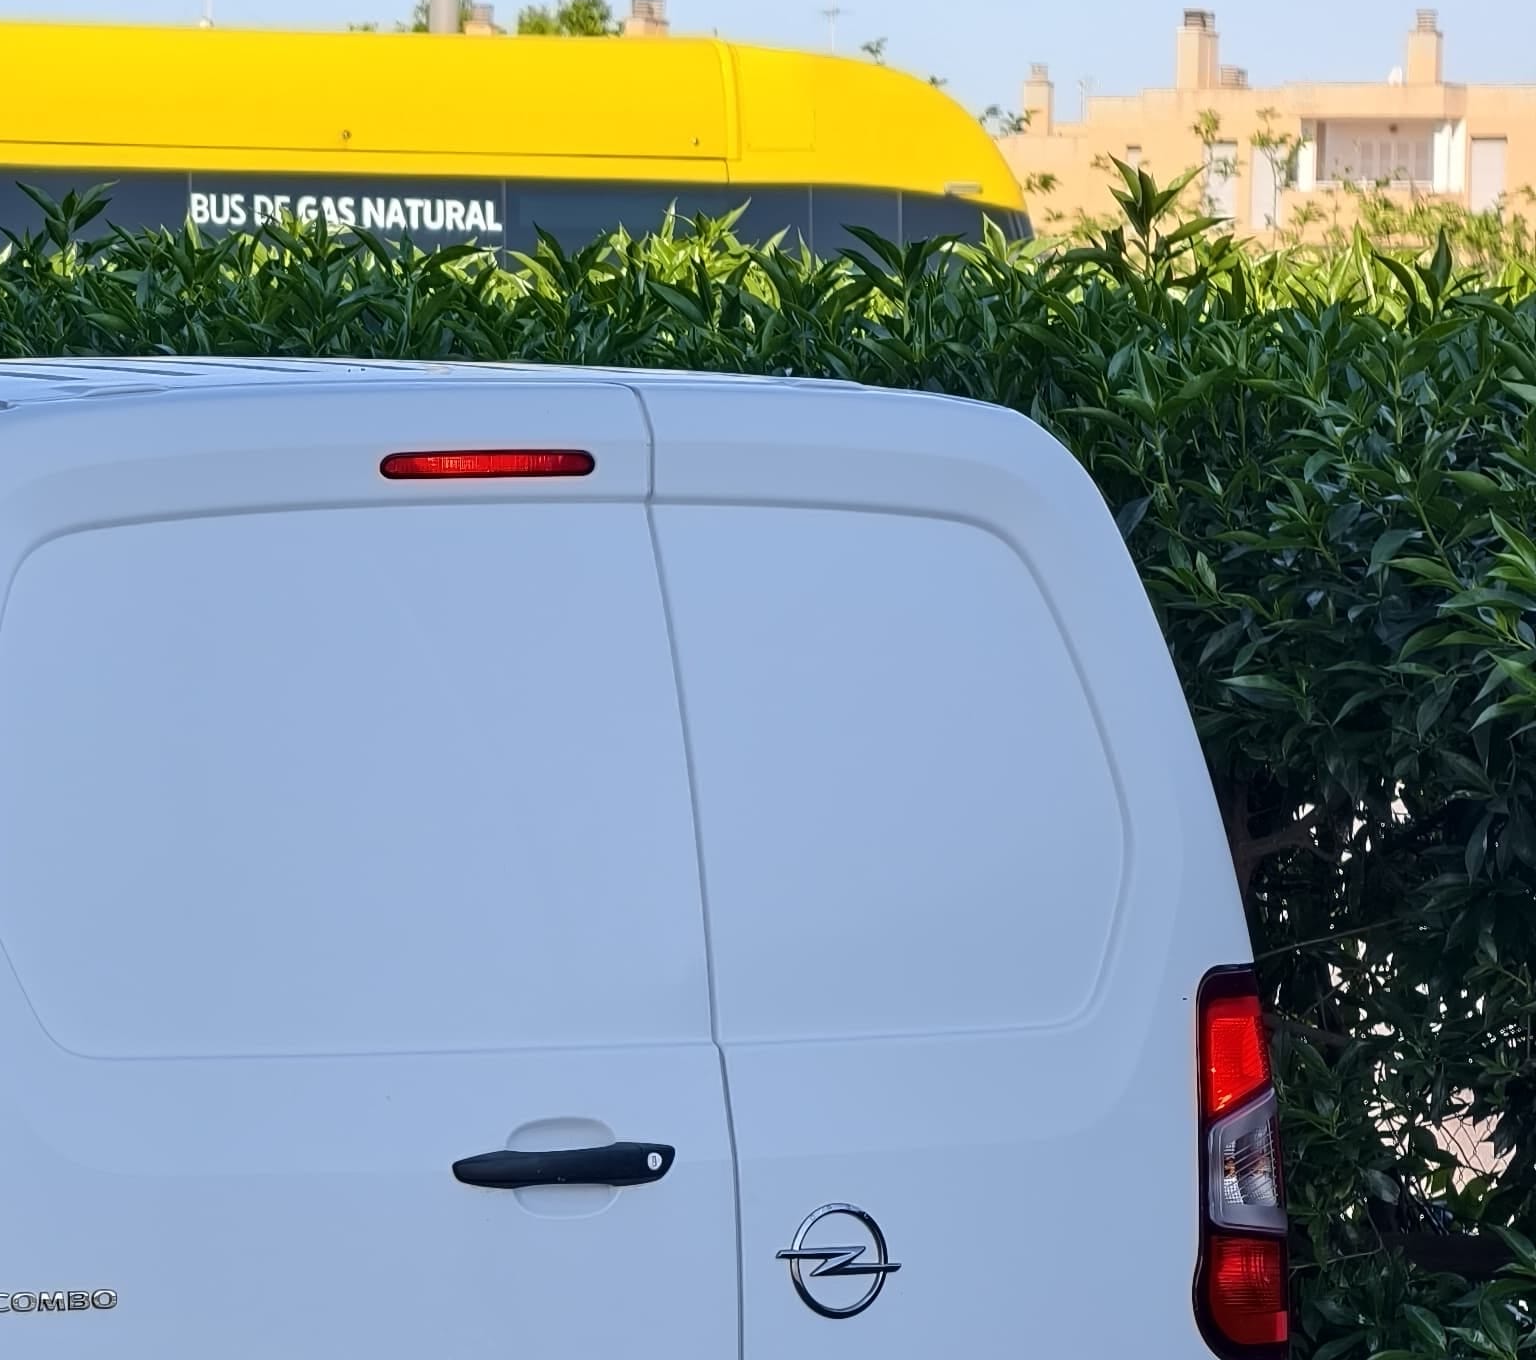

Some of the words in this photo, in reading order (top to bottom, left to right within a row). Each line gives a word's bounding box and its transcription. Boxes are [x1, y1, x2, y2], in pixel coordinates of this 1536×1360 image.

[190, 193, 246, 225] BUS
[296, 196, 356, 229] GAS
[363, 197, 503, 231] NATURAL
